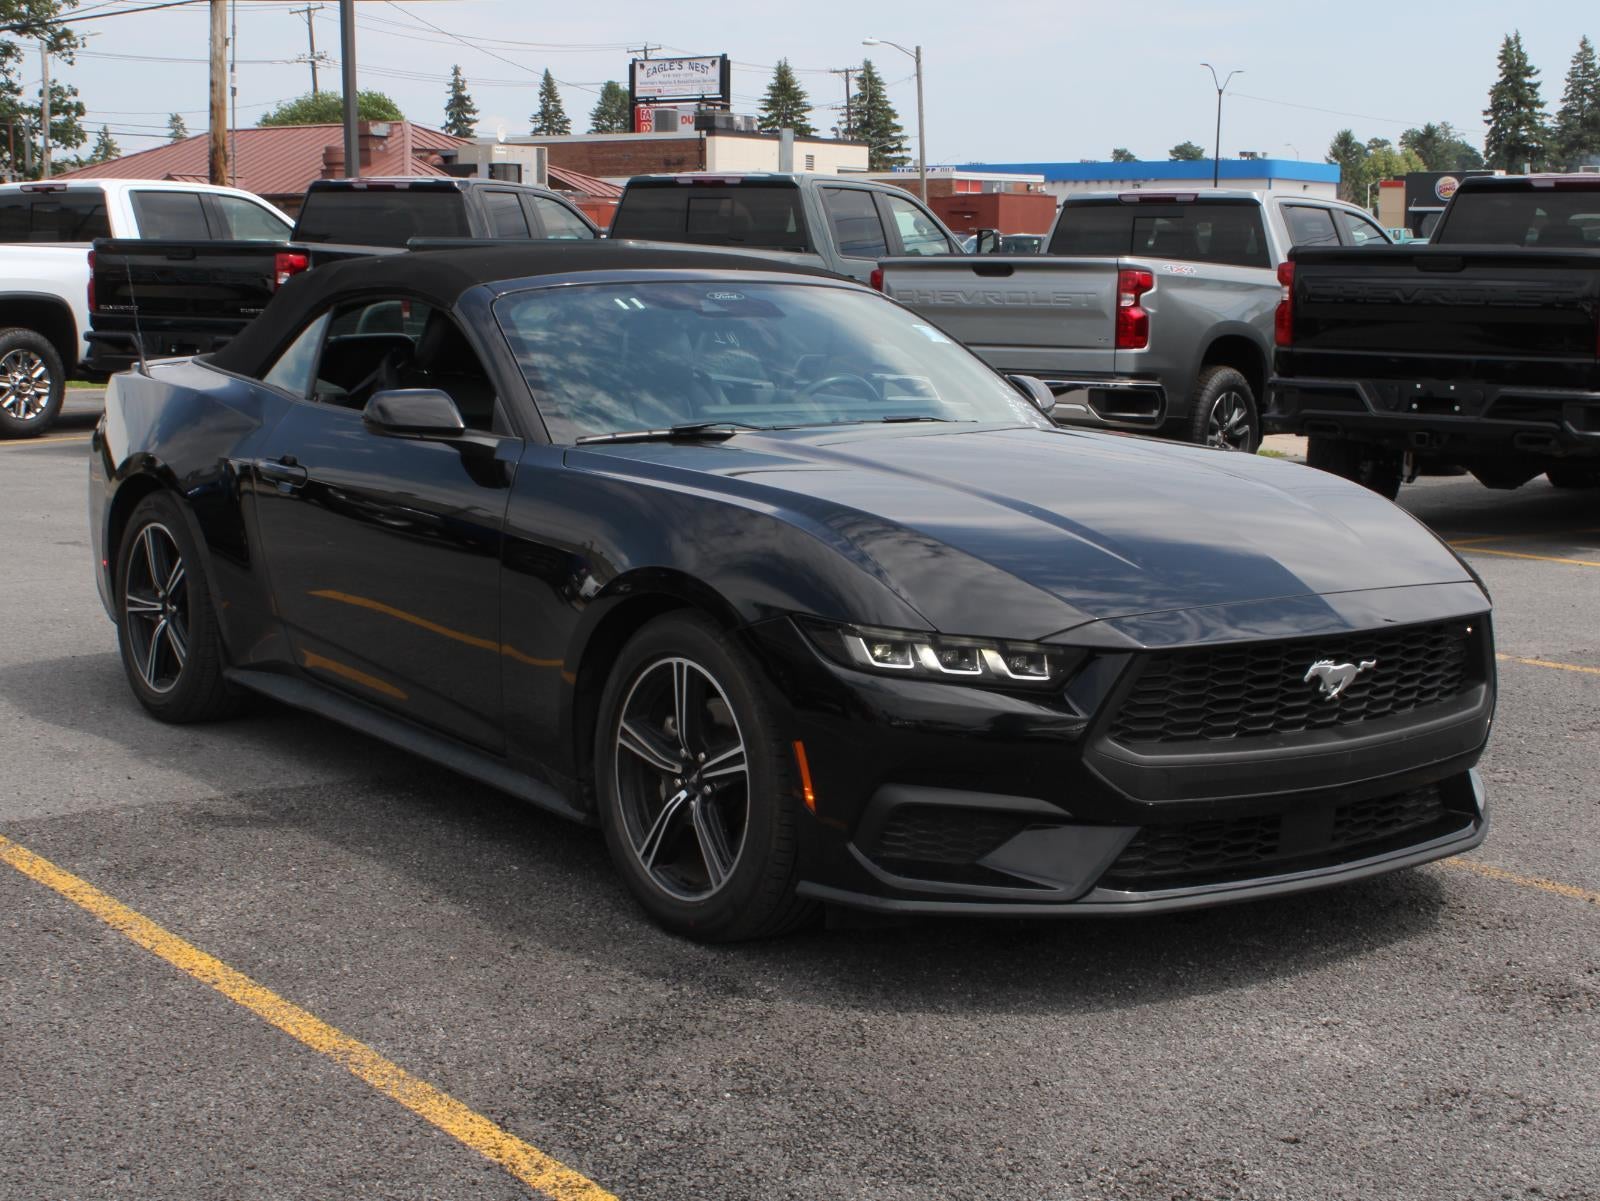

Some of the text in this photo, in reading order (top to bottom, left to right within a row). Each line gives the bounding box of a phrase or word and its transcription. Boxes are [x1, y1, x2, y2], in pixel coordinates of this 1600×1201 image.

[646, 60, 709, 78] EAGLE'S NEST
[714, 292, 737, 300] Ford
[895, 289, 1096, 306] CHEVROLET
